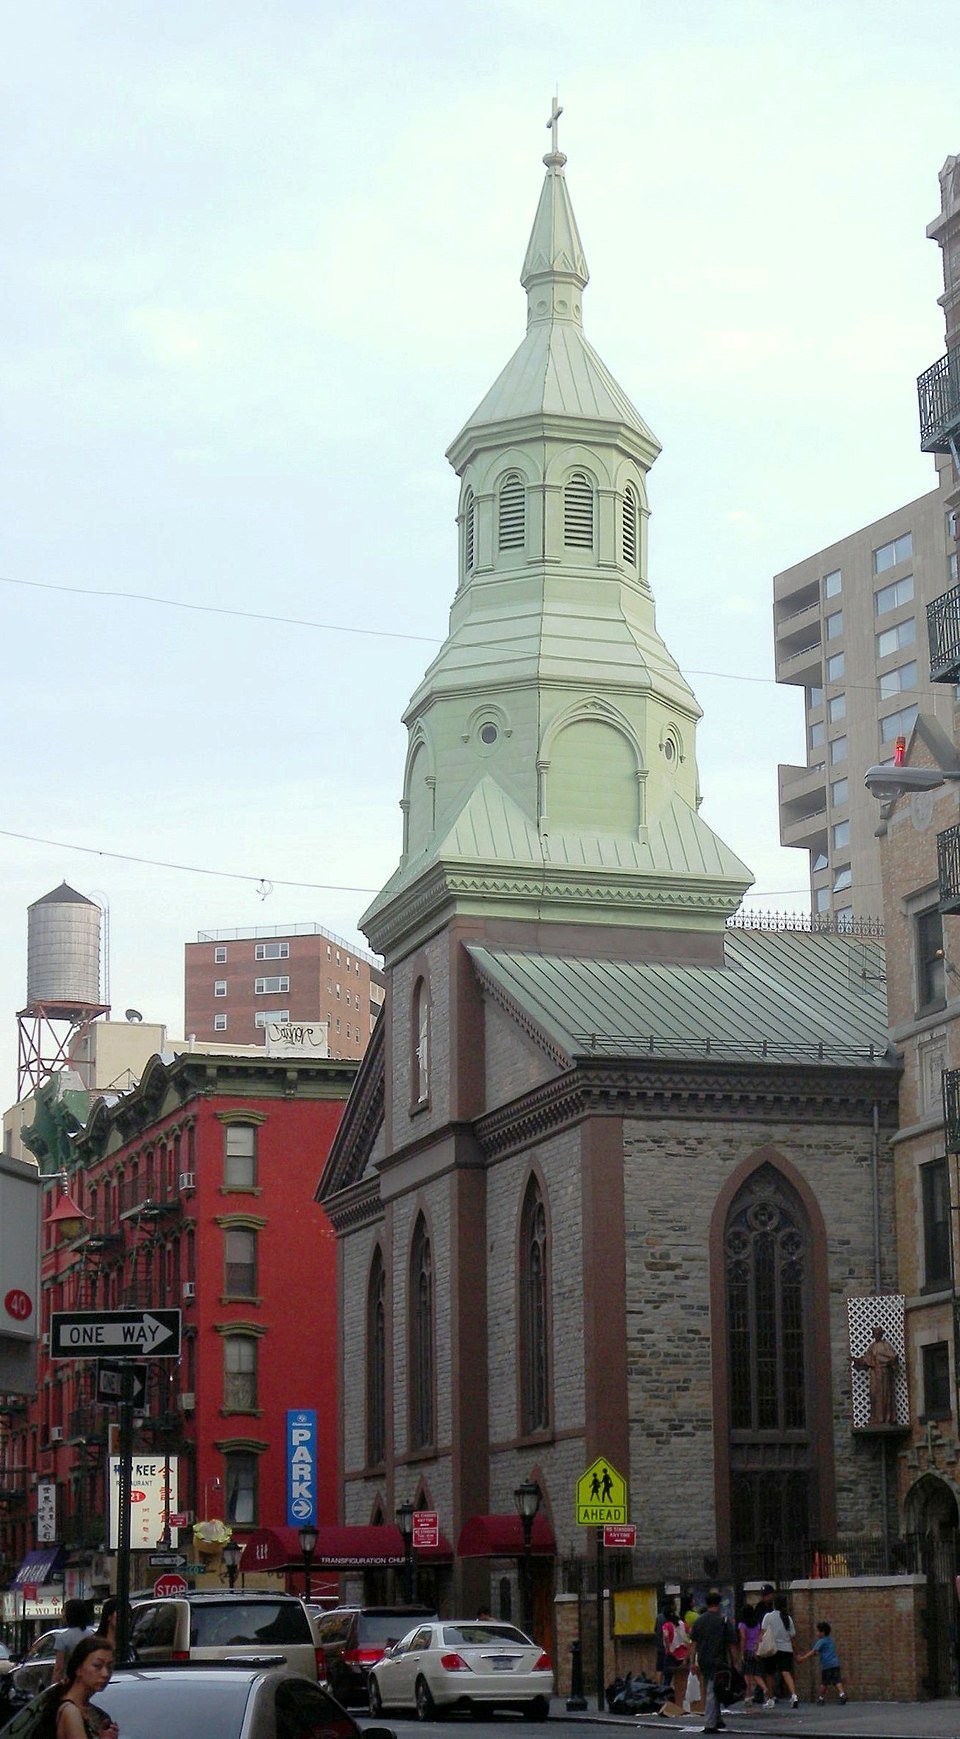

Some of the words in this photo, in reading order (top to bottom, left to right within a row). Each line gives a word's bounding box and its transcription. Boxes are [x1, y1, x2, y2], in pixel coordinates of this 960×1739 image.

[12, 1295, 26, 1316] 40
[69, 1326, 105, 1344] ONE
[122, 1325, 160, 1343] WAY
[136, 1464, 156, 1476] KEE
[291, 1429, 312, 1499] PARK
[582, 1509, 621, 1520] AHEAD
[157, 1585, 186, 1598] STOP
